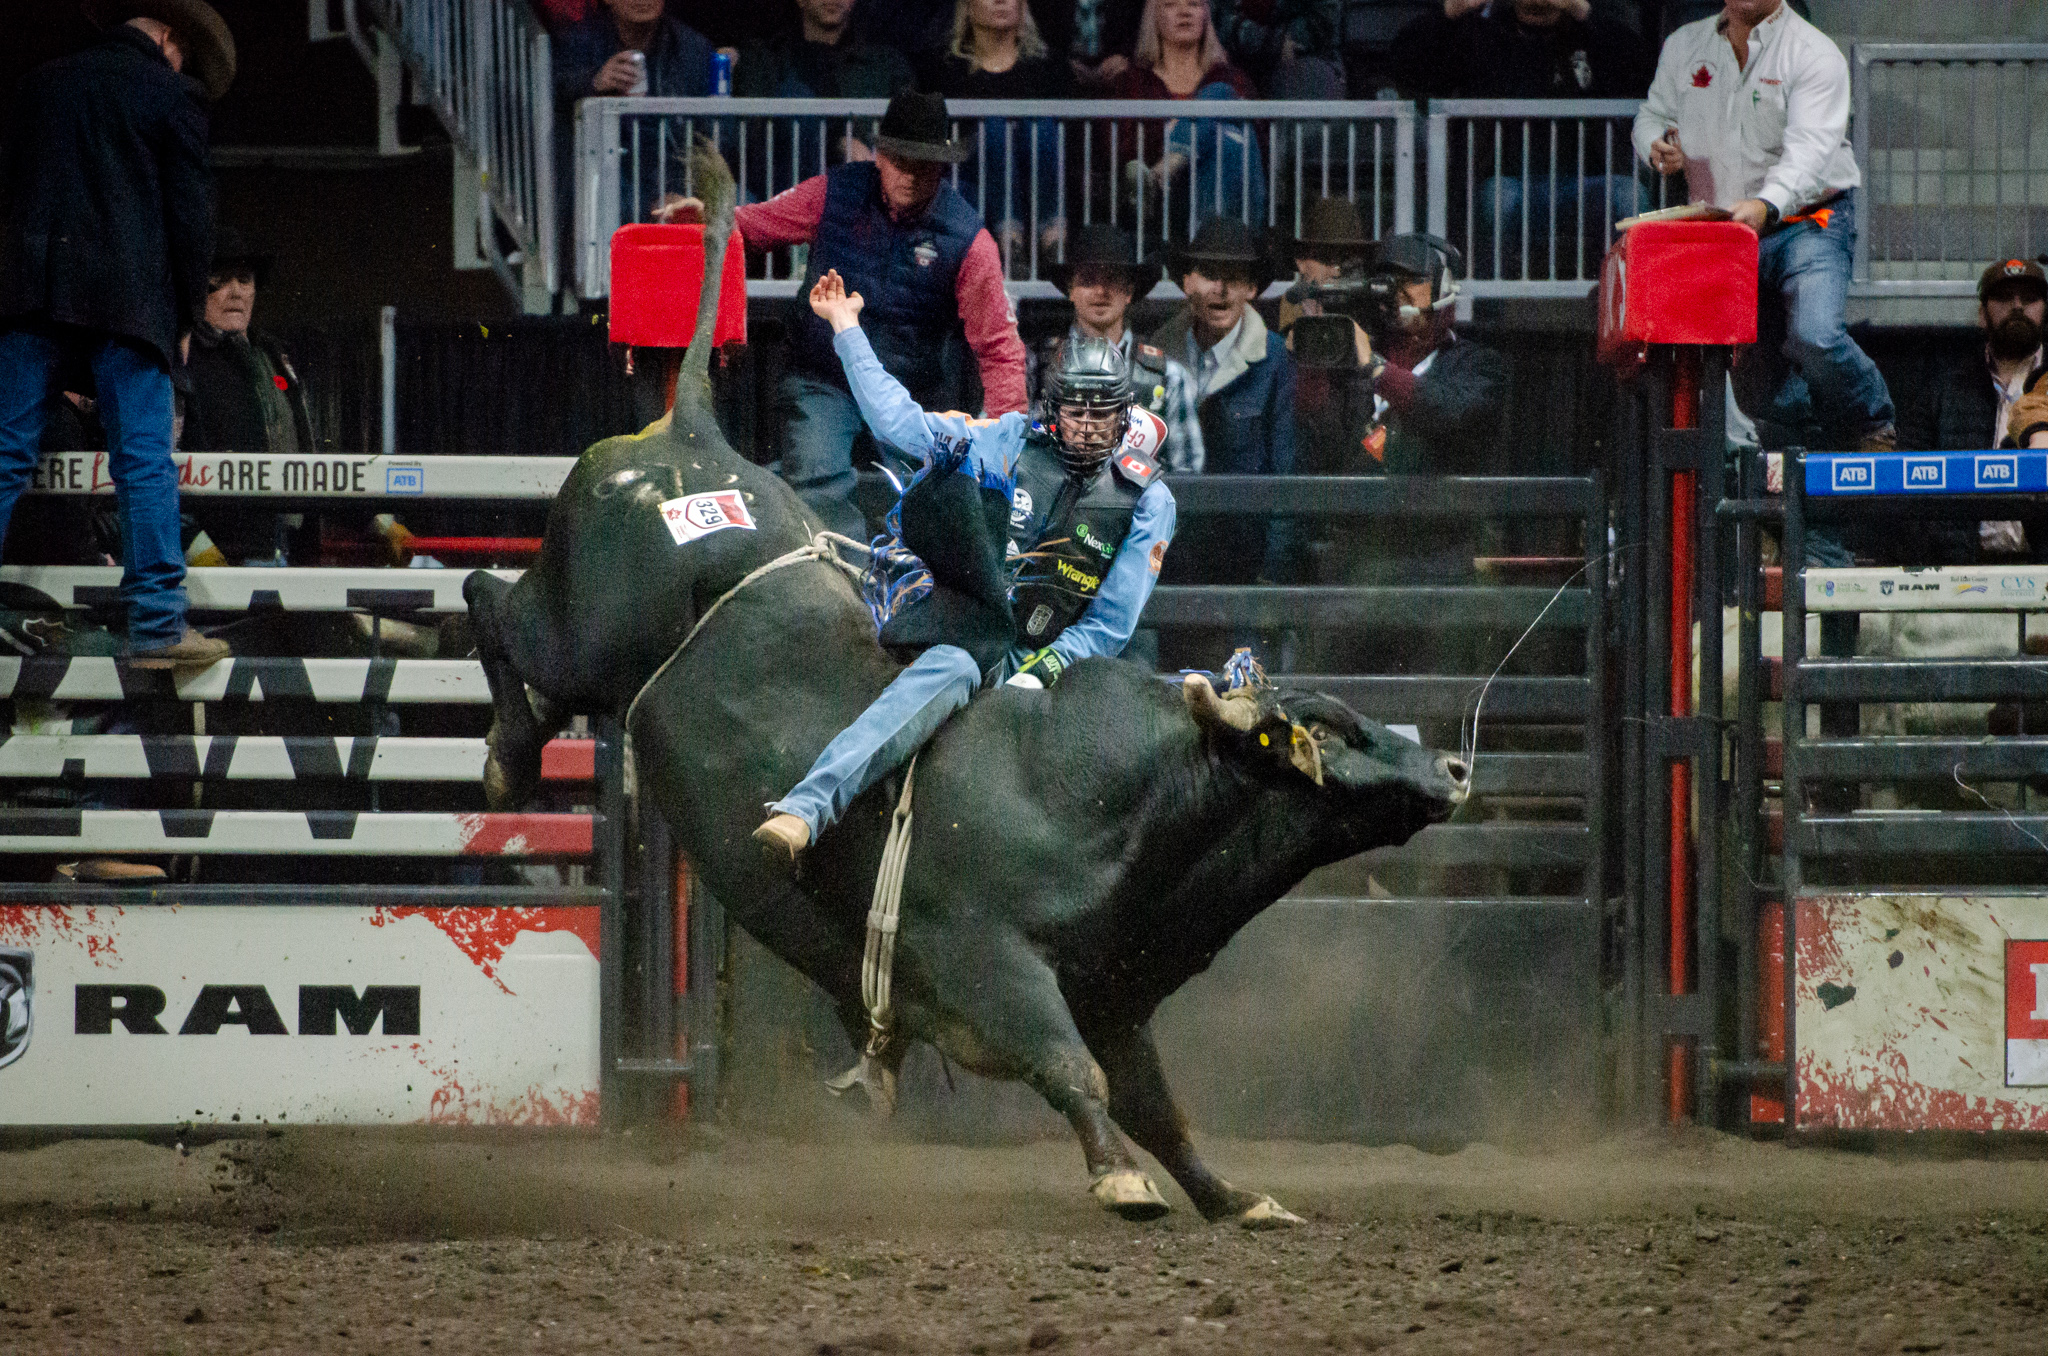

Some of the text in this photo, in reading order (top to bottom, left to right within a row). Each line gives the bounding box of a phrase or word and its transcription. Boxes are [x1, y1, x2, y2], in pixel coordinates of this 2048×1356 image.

[32, 457, 84, 490] ERE
[218, 459, 272, 491] ARE
[282, 459, 367, 492] MADE
[1839, 466, 1868, 482] ATB
[1911, 465, 1939, 481] ATB
[1982, 463, 2010, 479] ATB
[393, 474, 417, 487] ATB
[695, 500, 723, 526] 329
[1083, 532, 1114, 555] NexG
[1058, 558, 1100, 592] Wrangl
[2001, 575, 2035, 588] CVS
[1899, 583, 1940, 591] RAM
[74, 983, 421, 1036] RAM
